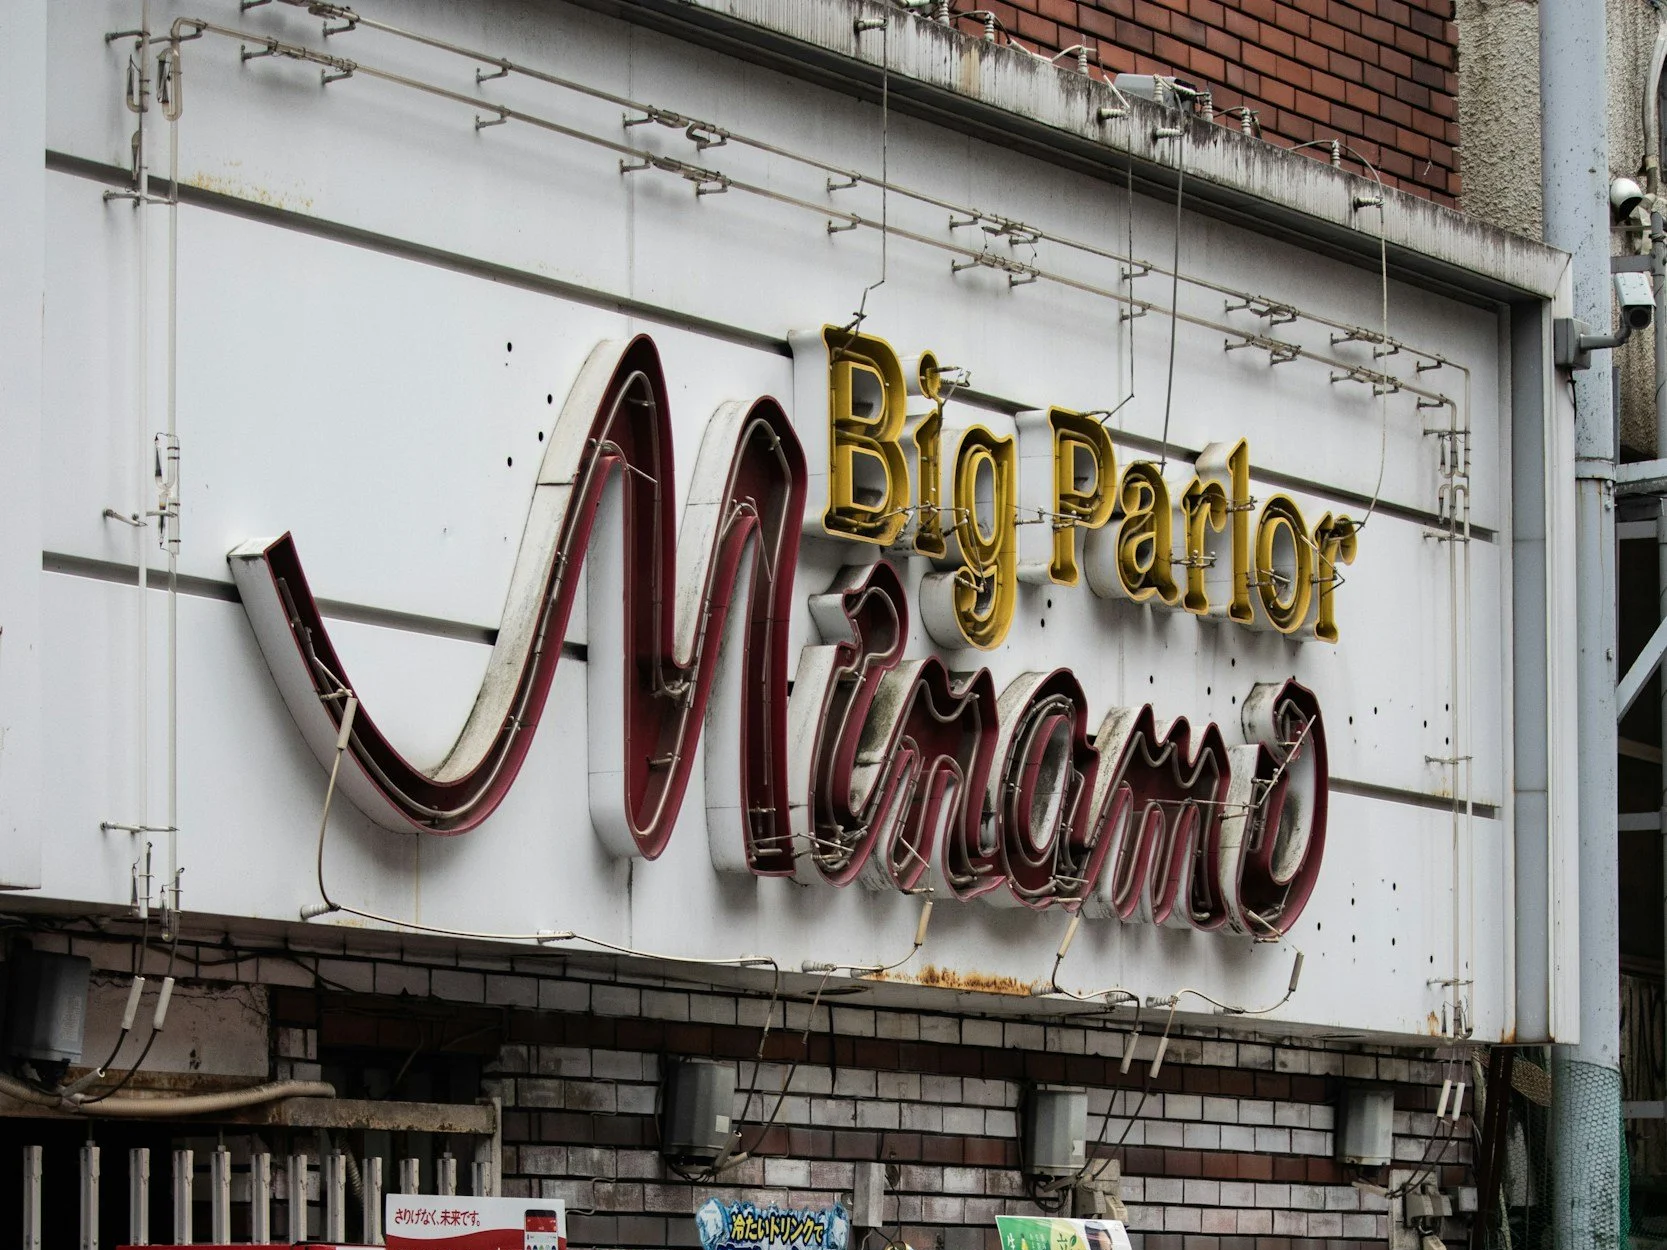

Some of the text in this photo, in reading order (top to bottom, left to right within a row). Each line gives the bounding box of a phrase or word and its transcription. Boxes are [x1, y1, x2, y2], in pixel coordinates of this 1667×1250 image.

[821, 323, 1357, 652] Big Parlor
[394, 1208, 481, 1226] さりげなく、未来です。
[732, 1214, 824, 1245] 冷たいドリンクで
